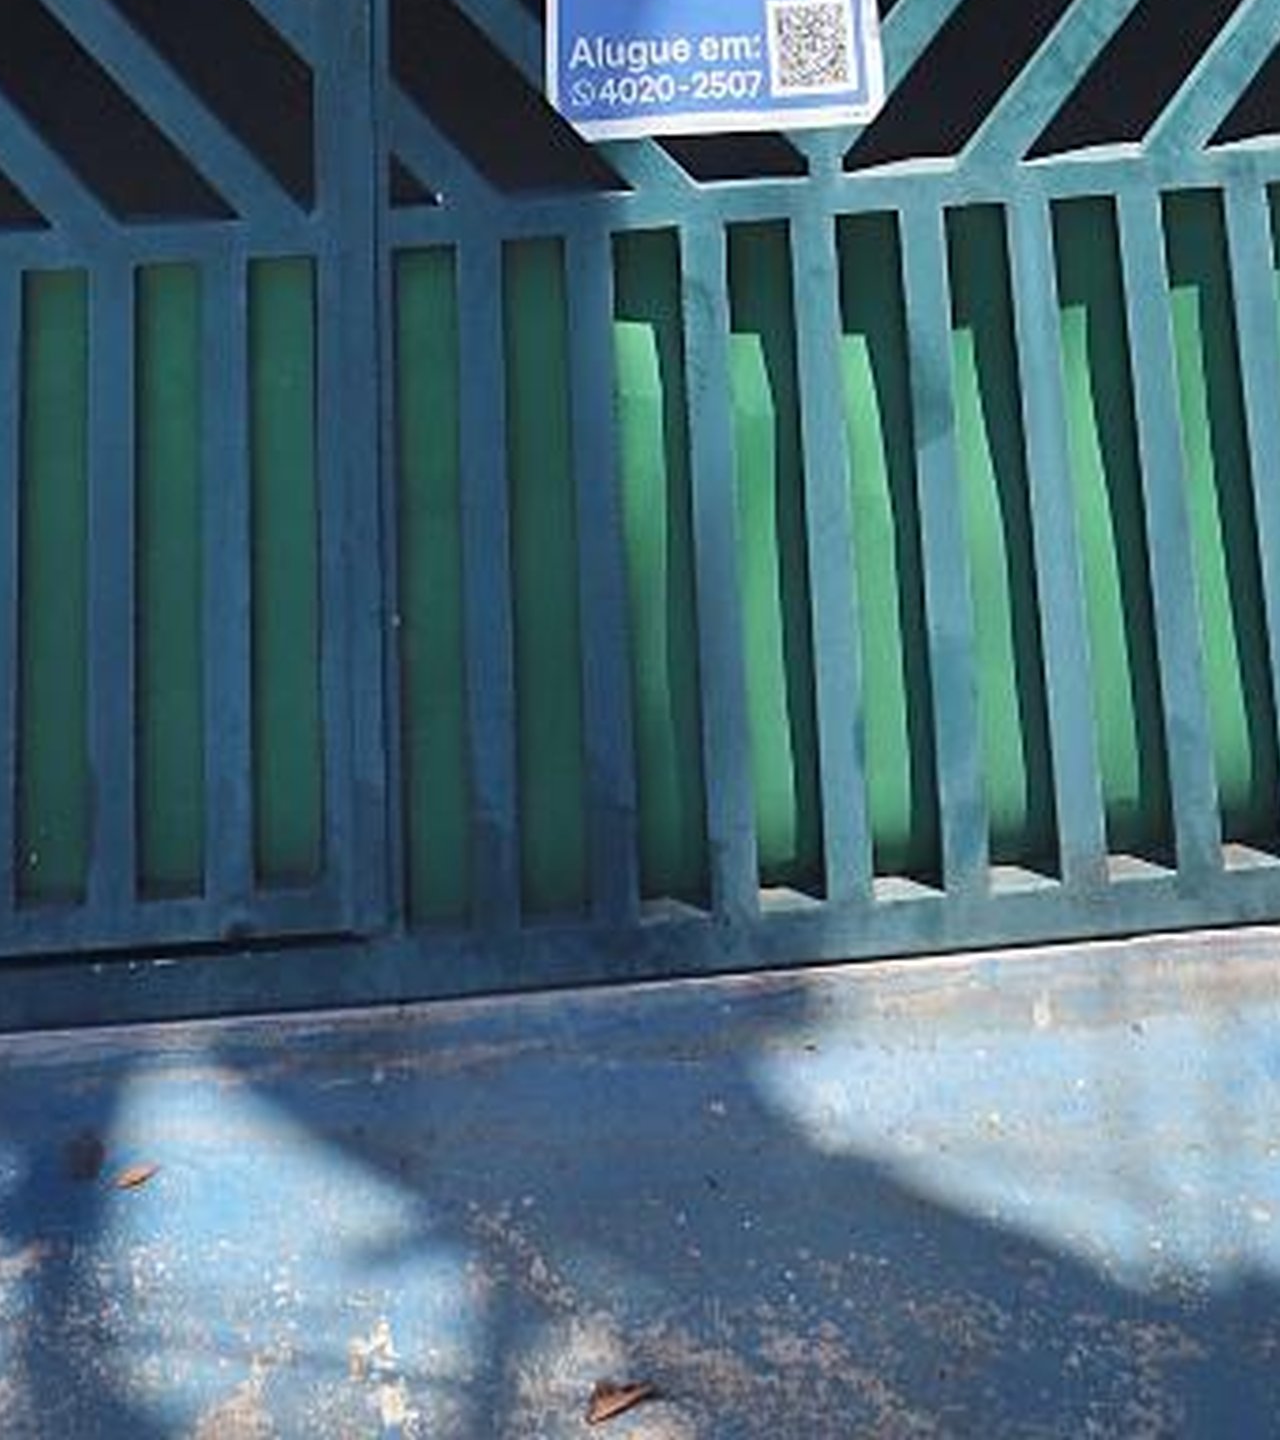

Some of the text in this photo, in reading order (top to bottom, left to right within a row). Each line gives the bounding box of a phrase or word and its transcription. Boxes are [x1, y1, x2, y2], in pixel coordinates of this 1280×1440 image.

[568, 33, 762, 73] Alugue em:
[598, 69, 763, 106] 4020-2507
